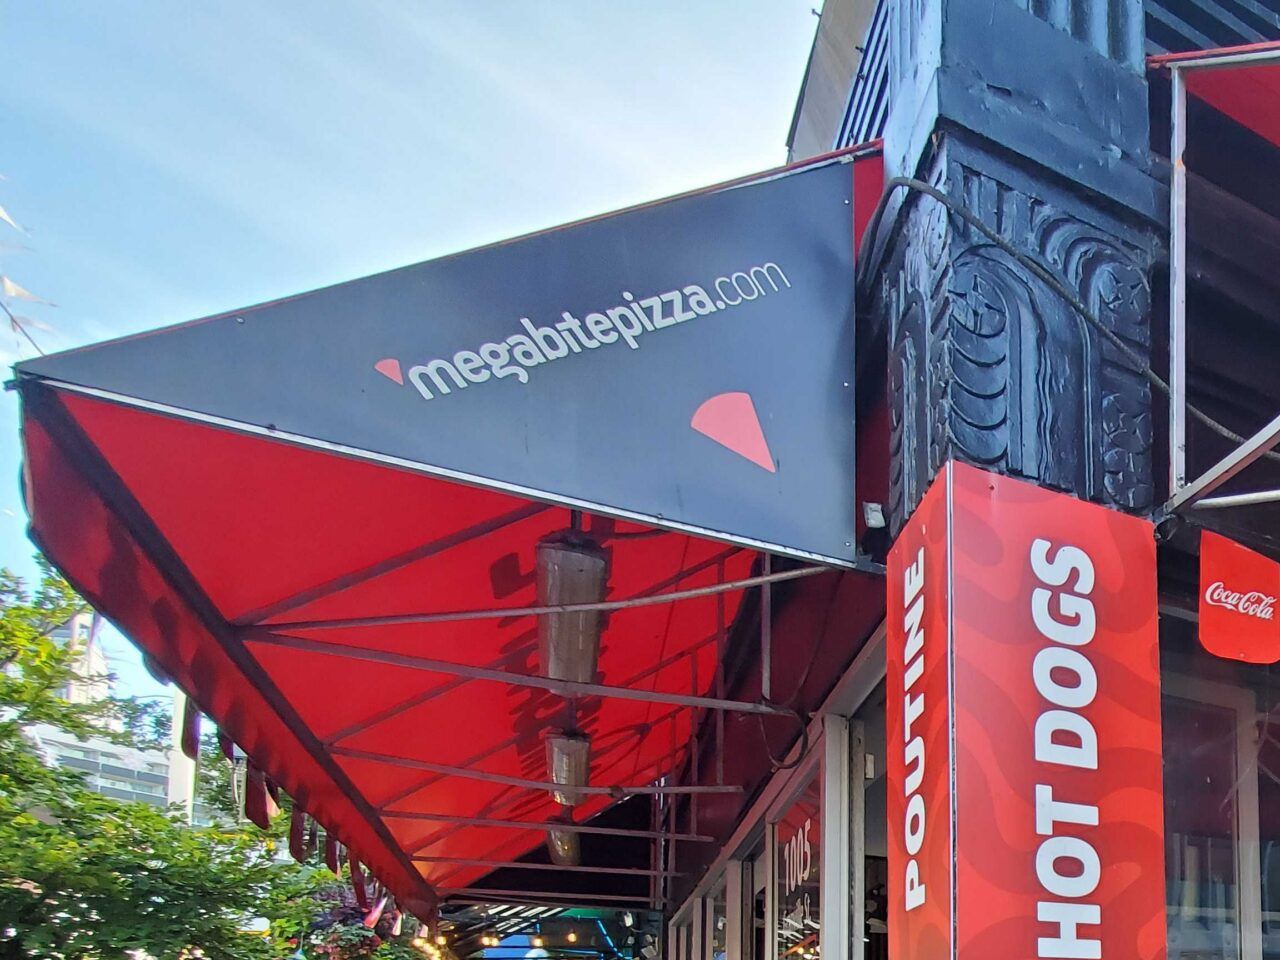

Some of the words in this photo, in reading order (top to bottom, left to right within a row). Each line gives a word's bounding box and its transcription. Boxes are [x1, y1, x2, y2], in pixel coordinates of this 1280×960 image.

[408, 261, 791, 400] megabitepizza.com
[1030, 537, 1099, 770] DOGS
[1205, 582, 1276, 619] Coca-Cola
[904, 546, 926, 911] POUTINE
[784, 818, 811, 897] 1005
[1035, 784, 1102, 959] HOT
